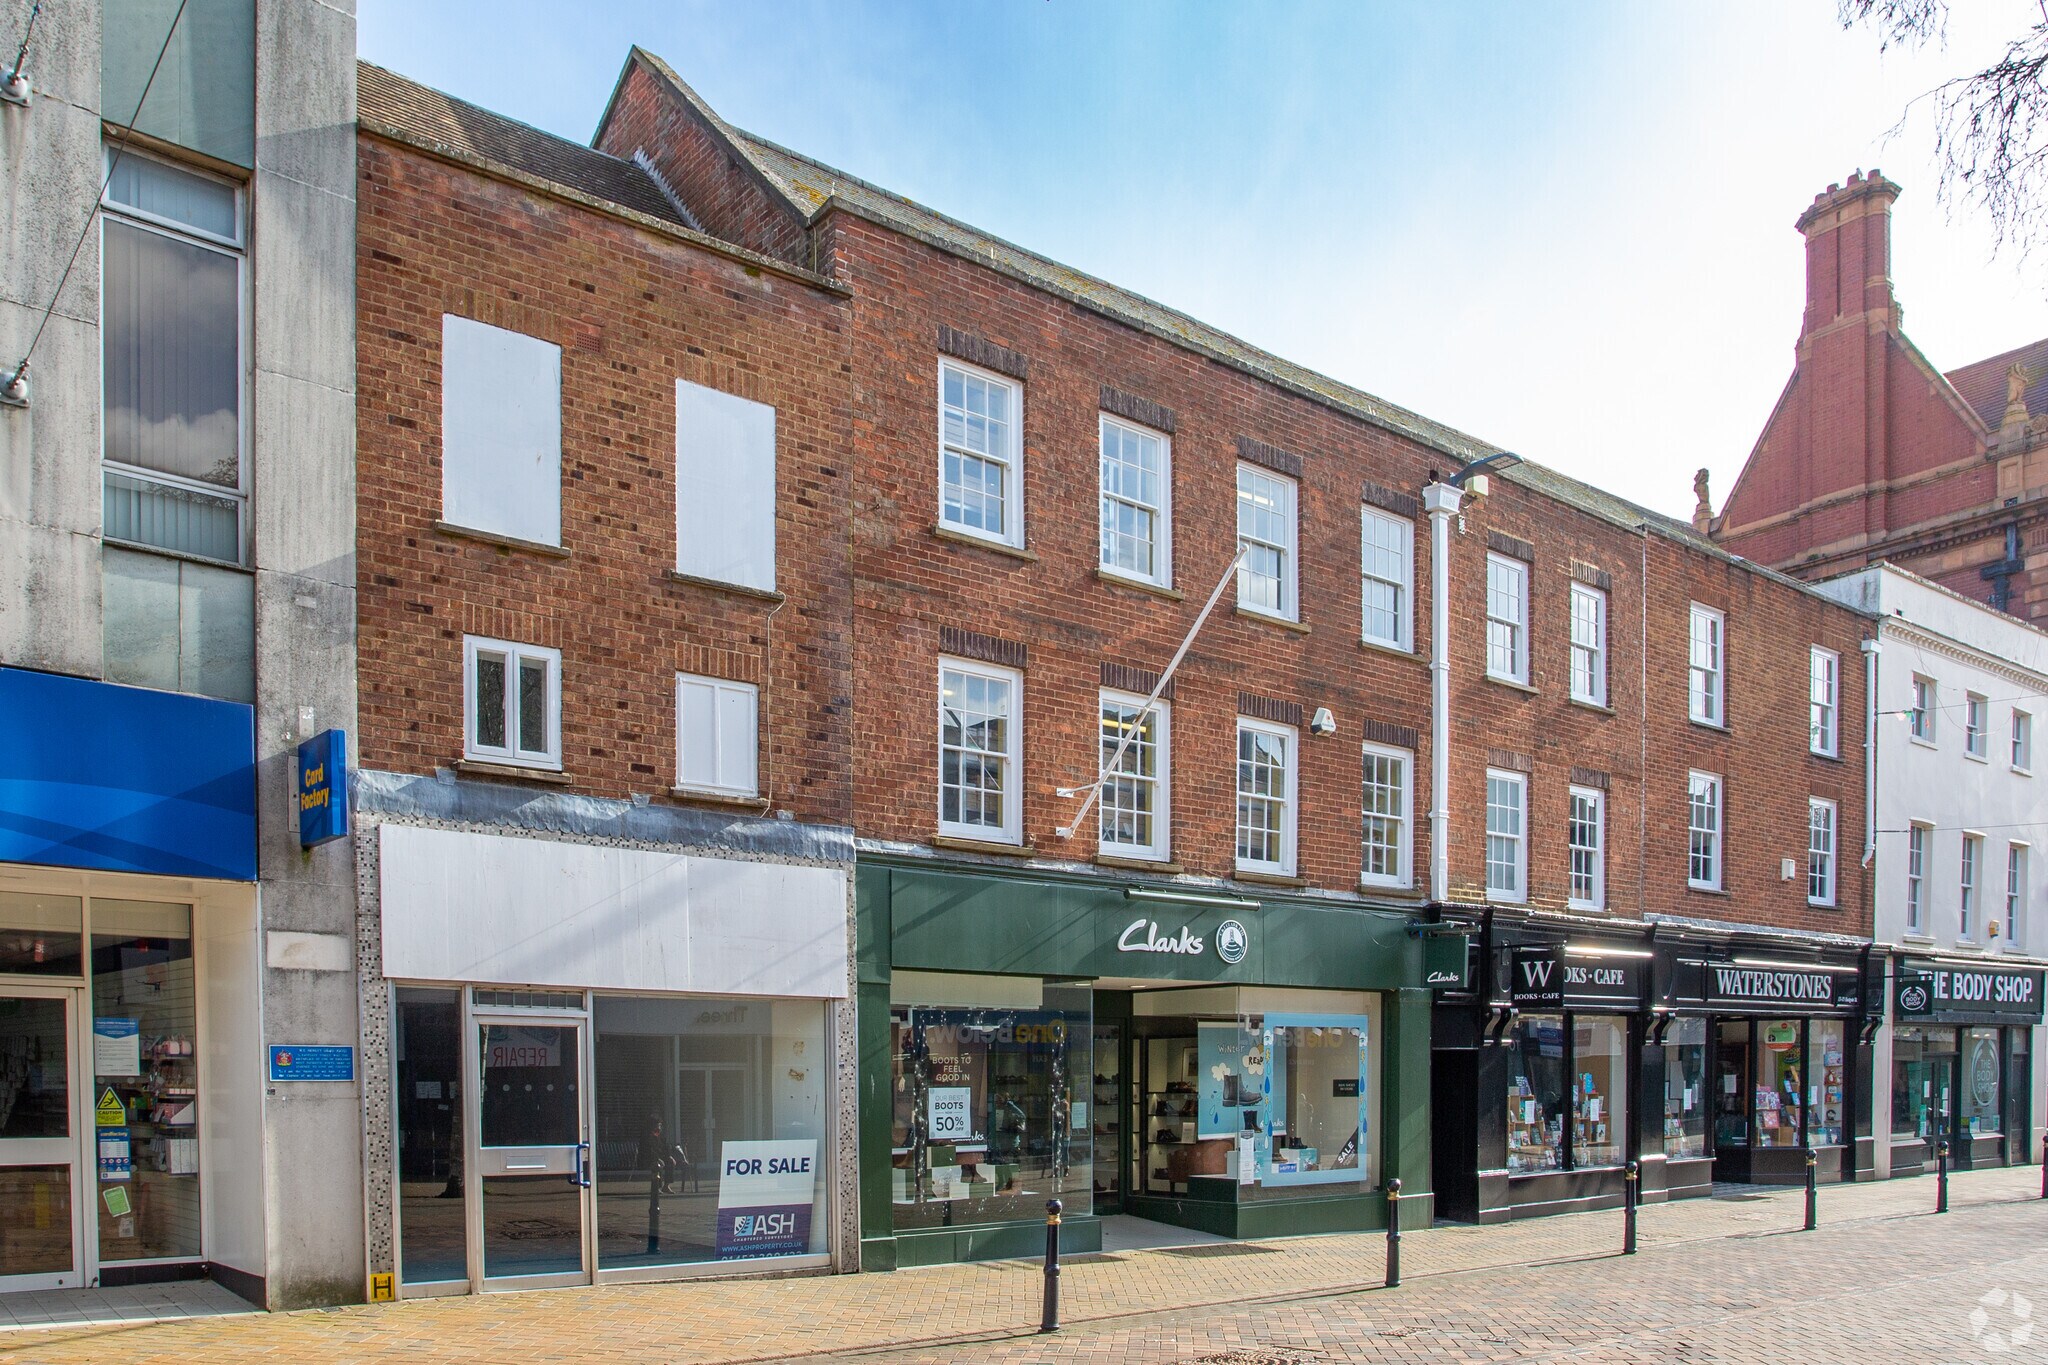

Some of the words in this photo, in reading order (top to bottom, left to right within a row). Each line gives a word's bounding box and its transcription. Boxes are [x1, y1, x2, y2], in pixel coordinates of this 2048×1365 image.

[305, 763, 324, 788] Card
[300, 787, 330, 812] Factory
[1118, 919, 1204, 954] Clarks
[1427, 972, 1460, 983] Clarks
[1520, 960, 1556, 988] W
[1594, 968, 1624, 985] CAFE
[1715, 968, 1832, 999] WATERSTONES
[1952, 972, 1992, 1000] BODY
[961, 1056, 972, 1064] TO
[936, 1074, 960, 1082] GOOD
[1976, 1070, 1993, 1081] BODY
[936, 1116, 964, 1131] 50%
[1338, 1141, 1354, 1164] SALE
[726, 1159, 762, 1176] FOR
[768, 1158, 810, 1174] SALE
[752, 1213, 795, 1236] ASH
[722, 1241, 802, 1252] WWW.ASHPROPERTY.CO.UK
[374, 1276, 392, 1298] H
